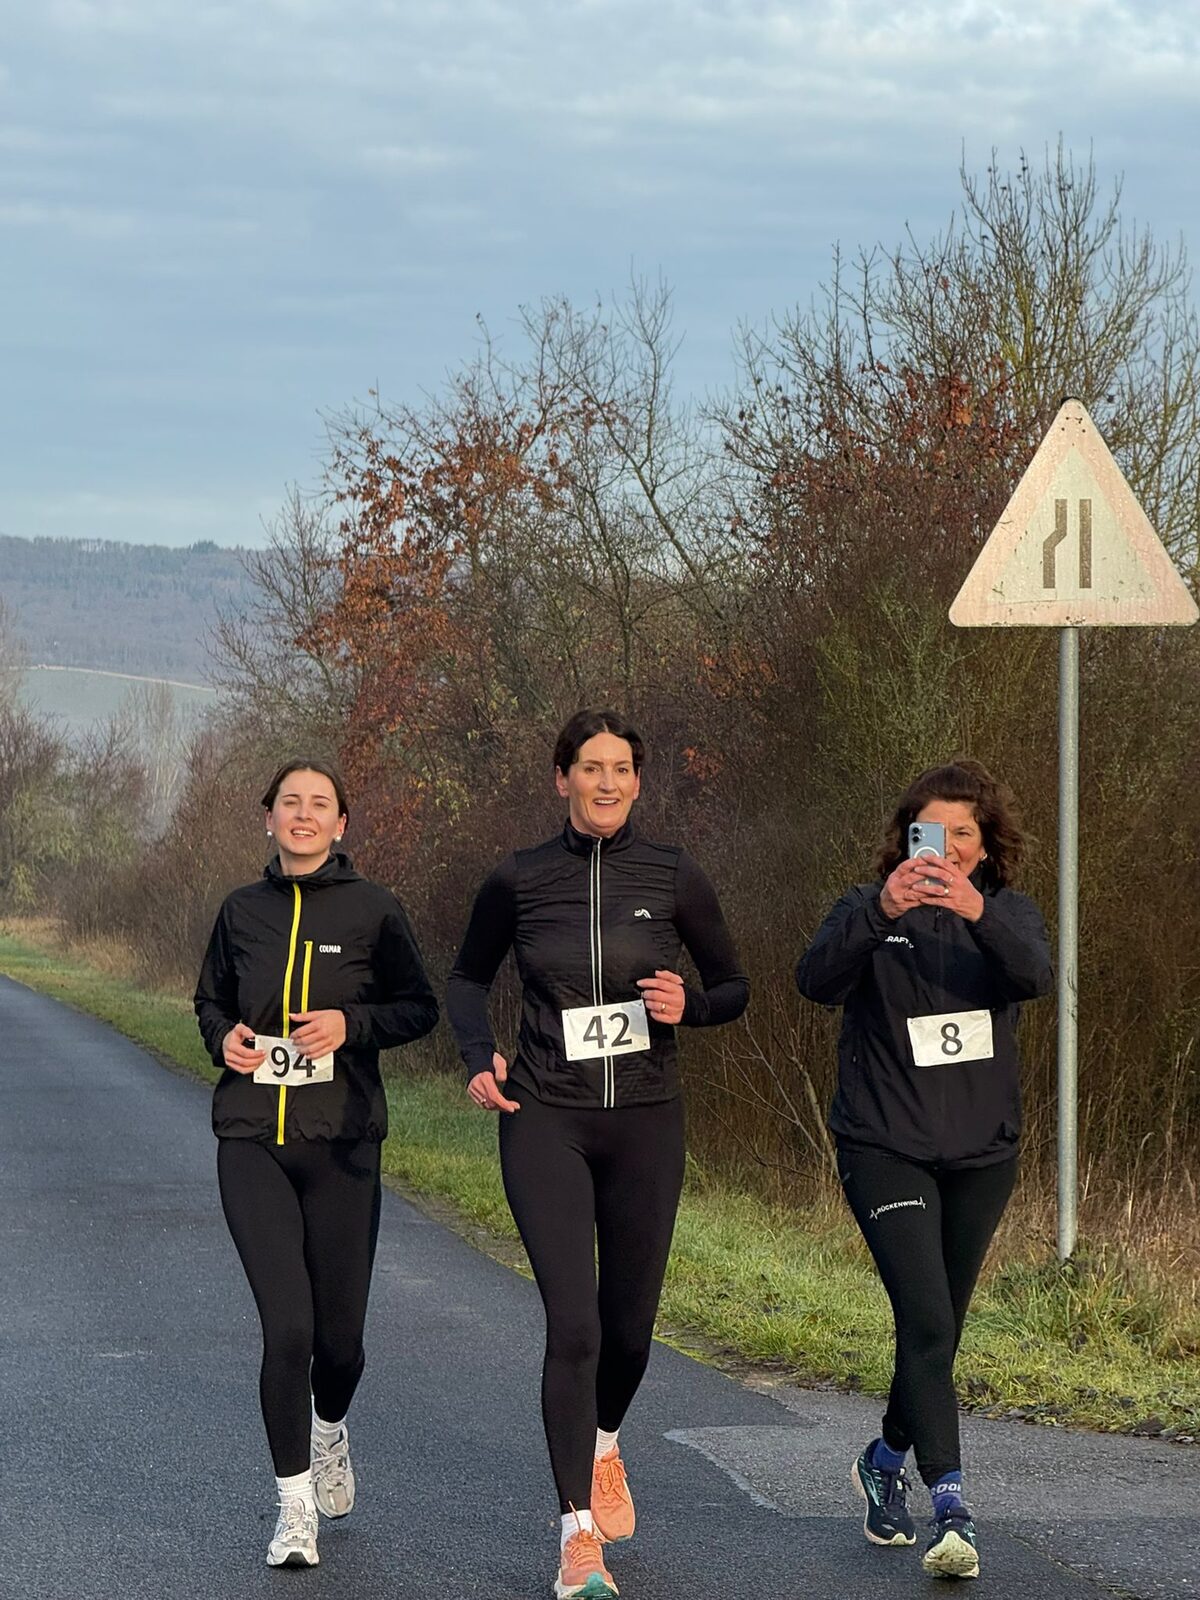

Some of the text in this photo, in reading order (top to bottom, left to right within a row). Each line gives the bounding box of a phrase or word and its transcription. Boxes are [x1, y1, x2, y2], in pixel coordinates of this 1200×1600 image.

[319, 944, 342, 953] COLMAR
[885, 935, 909, 945] RAFT
[583, 1012, 632, 1049] 42
[941, 1022, 963, 1056] 8
[271, 1046, 316, 1078] 94
